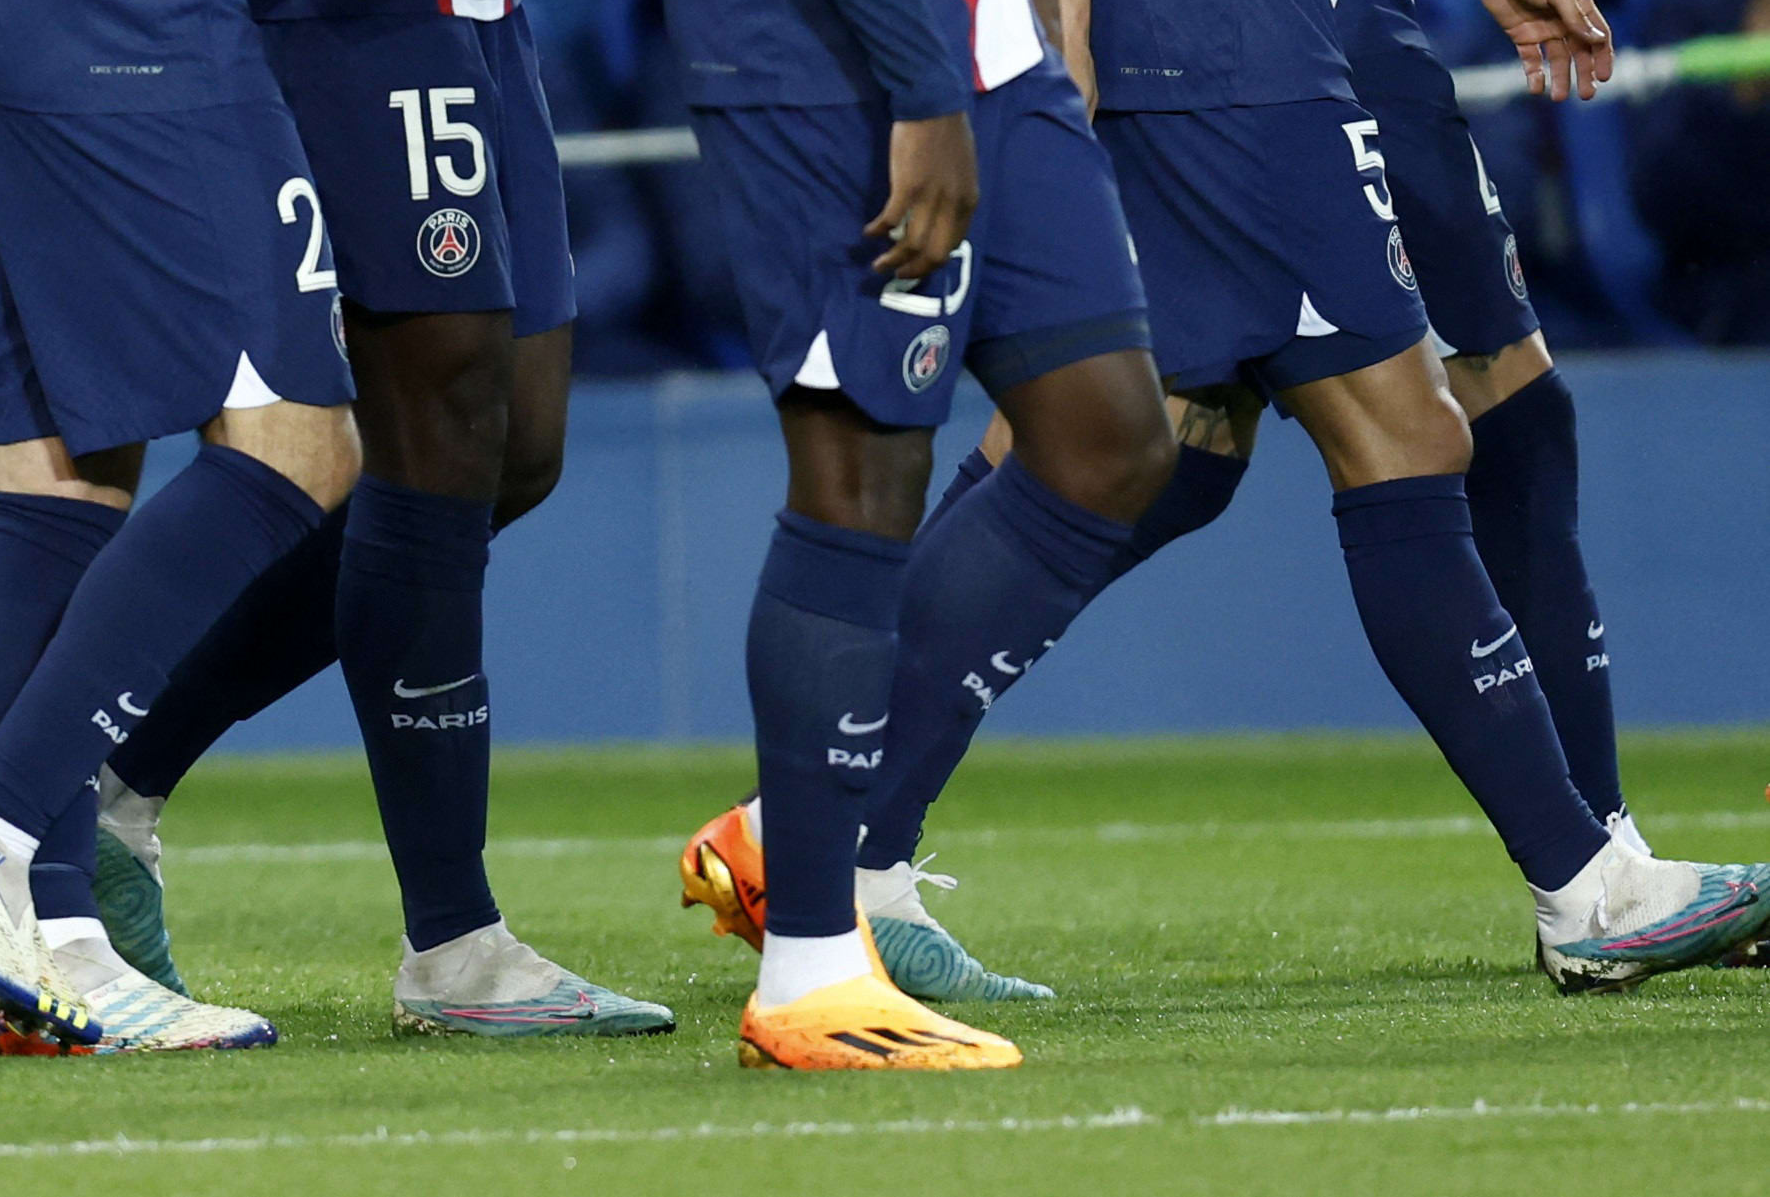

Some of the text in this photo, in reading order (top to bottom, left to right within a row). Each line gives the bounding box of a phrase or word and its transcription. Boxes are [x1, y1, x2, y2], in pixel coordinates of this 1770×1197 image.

[389, 87, 487, 200] 15
[1341, 119, 1397, 221] 5
[276, 177, 337, 293] 2
[427, 211, 470, 230] PARIS
[391, 705, 488, 730] PARIS
